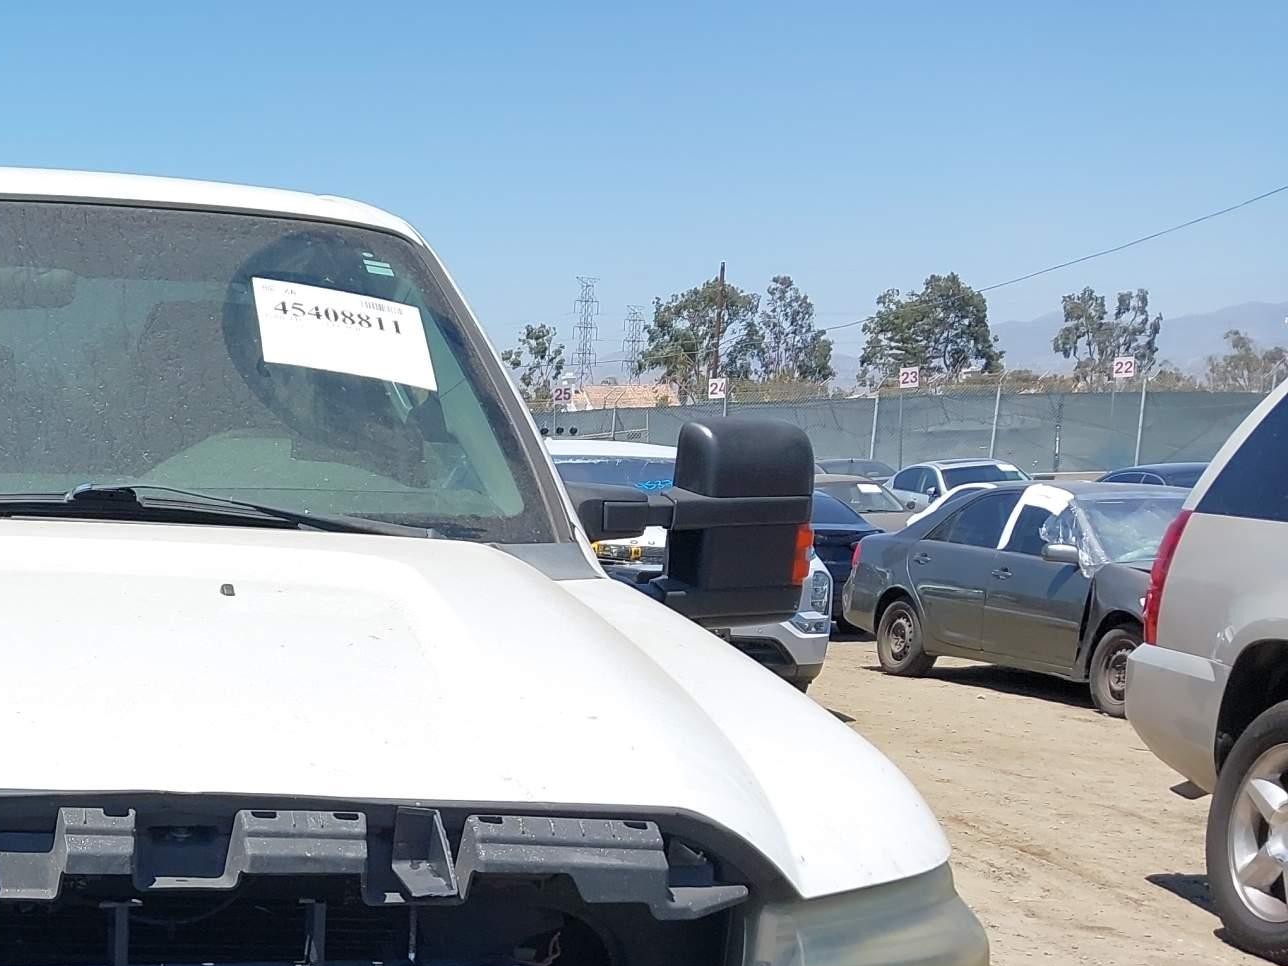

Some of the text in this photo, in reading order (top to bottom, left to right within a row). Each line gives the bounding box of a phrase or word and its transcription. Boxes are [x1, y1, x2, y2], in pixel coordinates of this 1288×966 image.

[274, 301, 401, 334] 45408811
[1115, 361, 1133, 373] 22
[902, 371, 918, 384] 23
[555, 388, 571, 401] 25
[710, 382, 726, 395] 24
